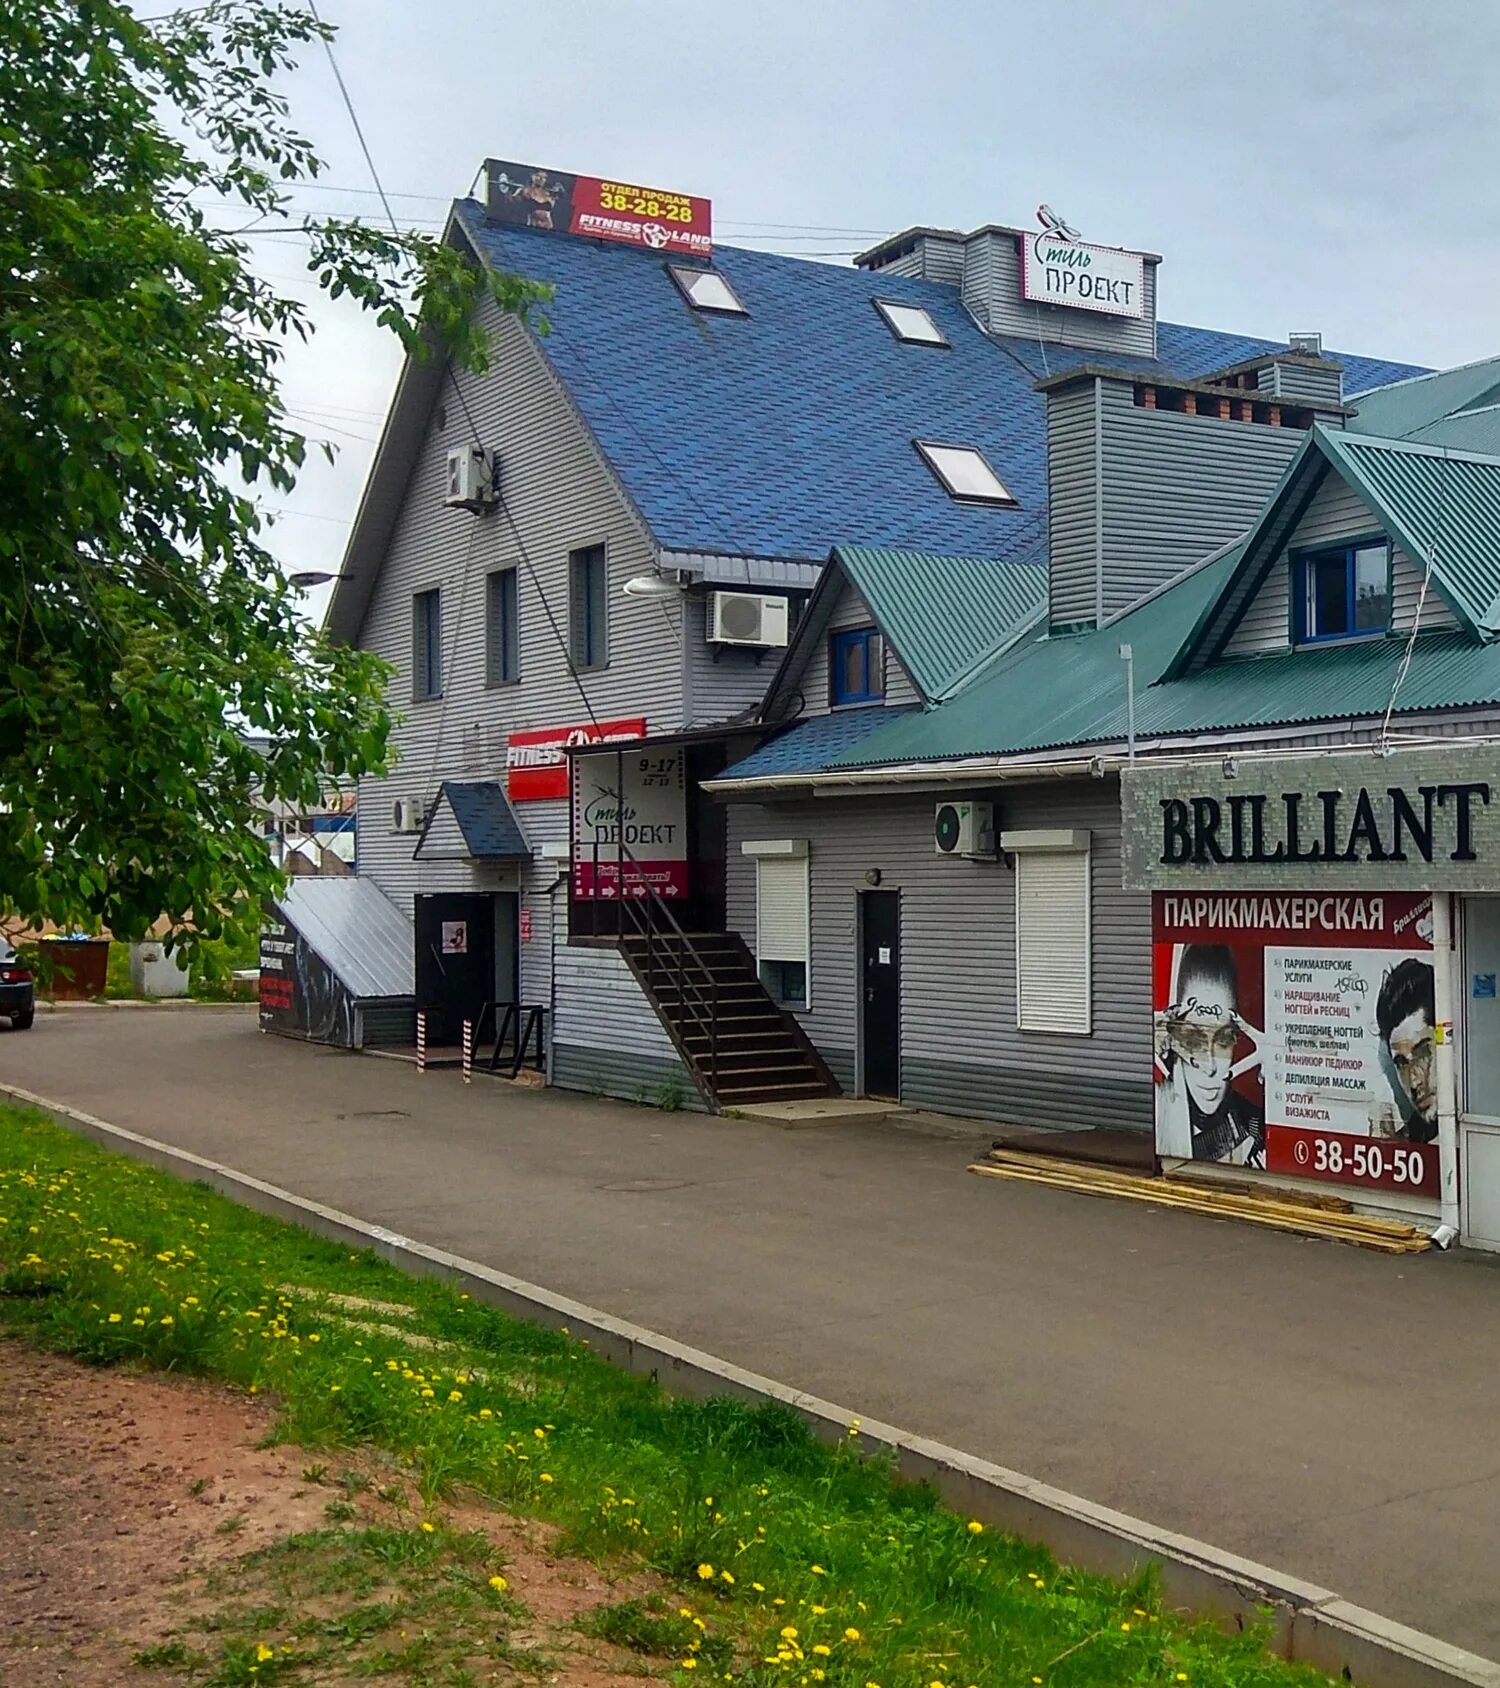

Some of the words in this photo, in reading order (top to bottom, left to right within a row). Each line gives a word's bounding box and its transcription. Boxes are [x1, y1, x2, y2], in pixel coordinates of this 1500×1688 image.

[601, 182, 640, 197] ОТДЕЛ
[642, 190, 691, 206] ПРОДАЖ
[600, 192, 692, 223] 38-28-28
[579, 214, 642, 234] FITNESS
[671, 231, 711, 245] LAND
[1046, 267, 1134, 305] ПРОЕКТ
[639, 758, 675, 772] 9-17
[1158, 782, 1490, 864] BRILLIANT
[1164, 897, 1384, 930] ПАРИКМАХЕРСКАЯ
[1284, 959, 1352, 971] ПАРИКМАХЕРСКИЕ
[1284, 972, 1312, 983] УСЛУГИ
[1284, 990, 1341, 1002] НАРАЩИВАНИЕ
[1284, 1002, 1312, 1015] НОГТЕЙ
[1320, 1006, 1350, 1018] РЕСНИЦ
[1285, 1023, 1332, 1035] УКРЕПЛЕНИЕ
[1334, 1026, 1363, 1038] НОГТЕЙ
[1285, 1054, 1323, 1067] МАНИКЮР
[1325, 1058, 1363, 1070] ПЕДИКЮР
[1285, 1073, 1330, 1087] ДЕПИЛЯЦИЯ
[1332, 1077, 1366, 1090] МАССАЖ
[1285, 1093, 1313, 1104] УСЛУГИ
[1285, 1106, 1330, 1120] ВИЗАЖИСТА
[1314, 1139, 1424, 1184] 38-50-50
